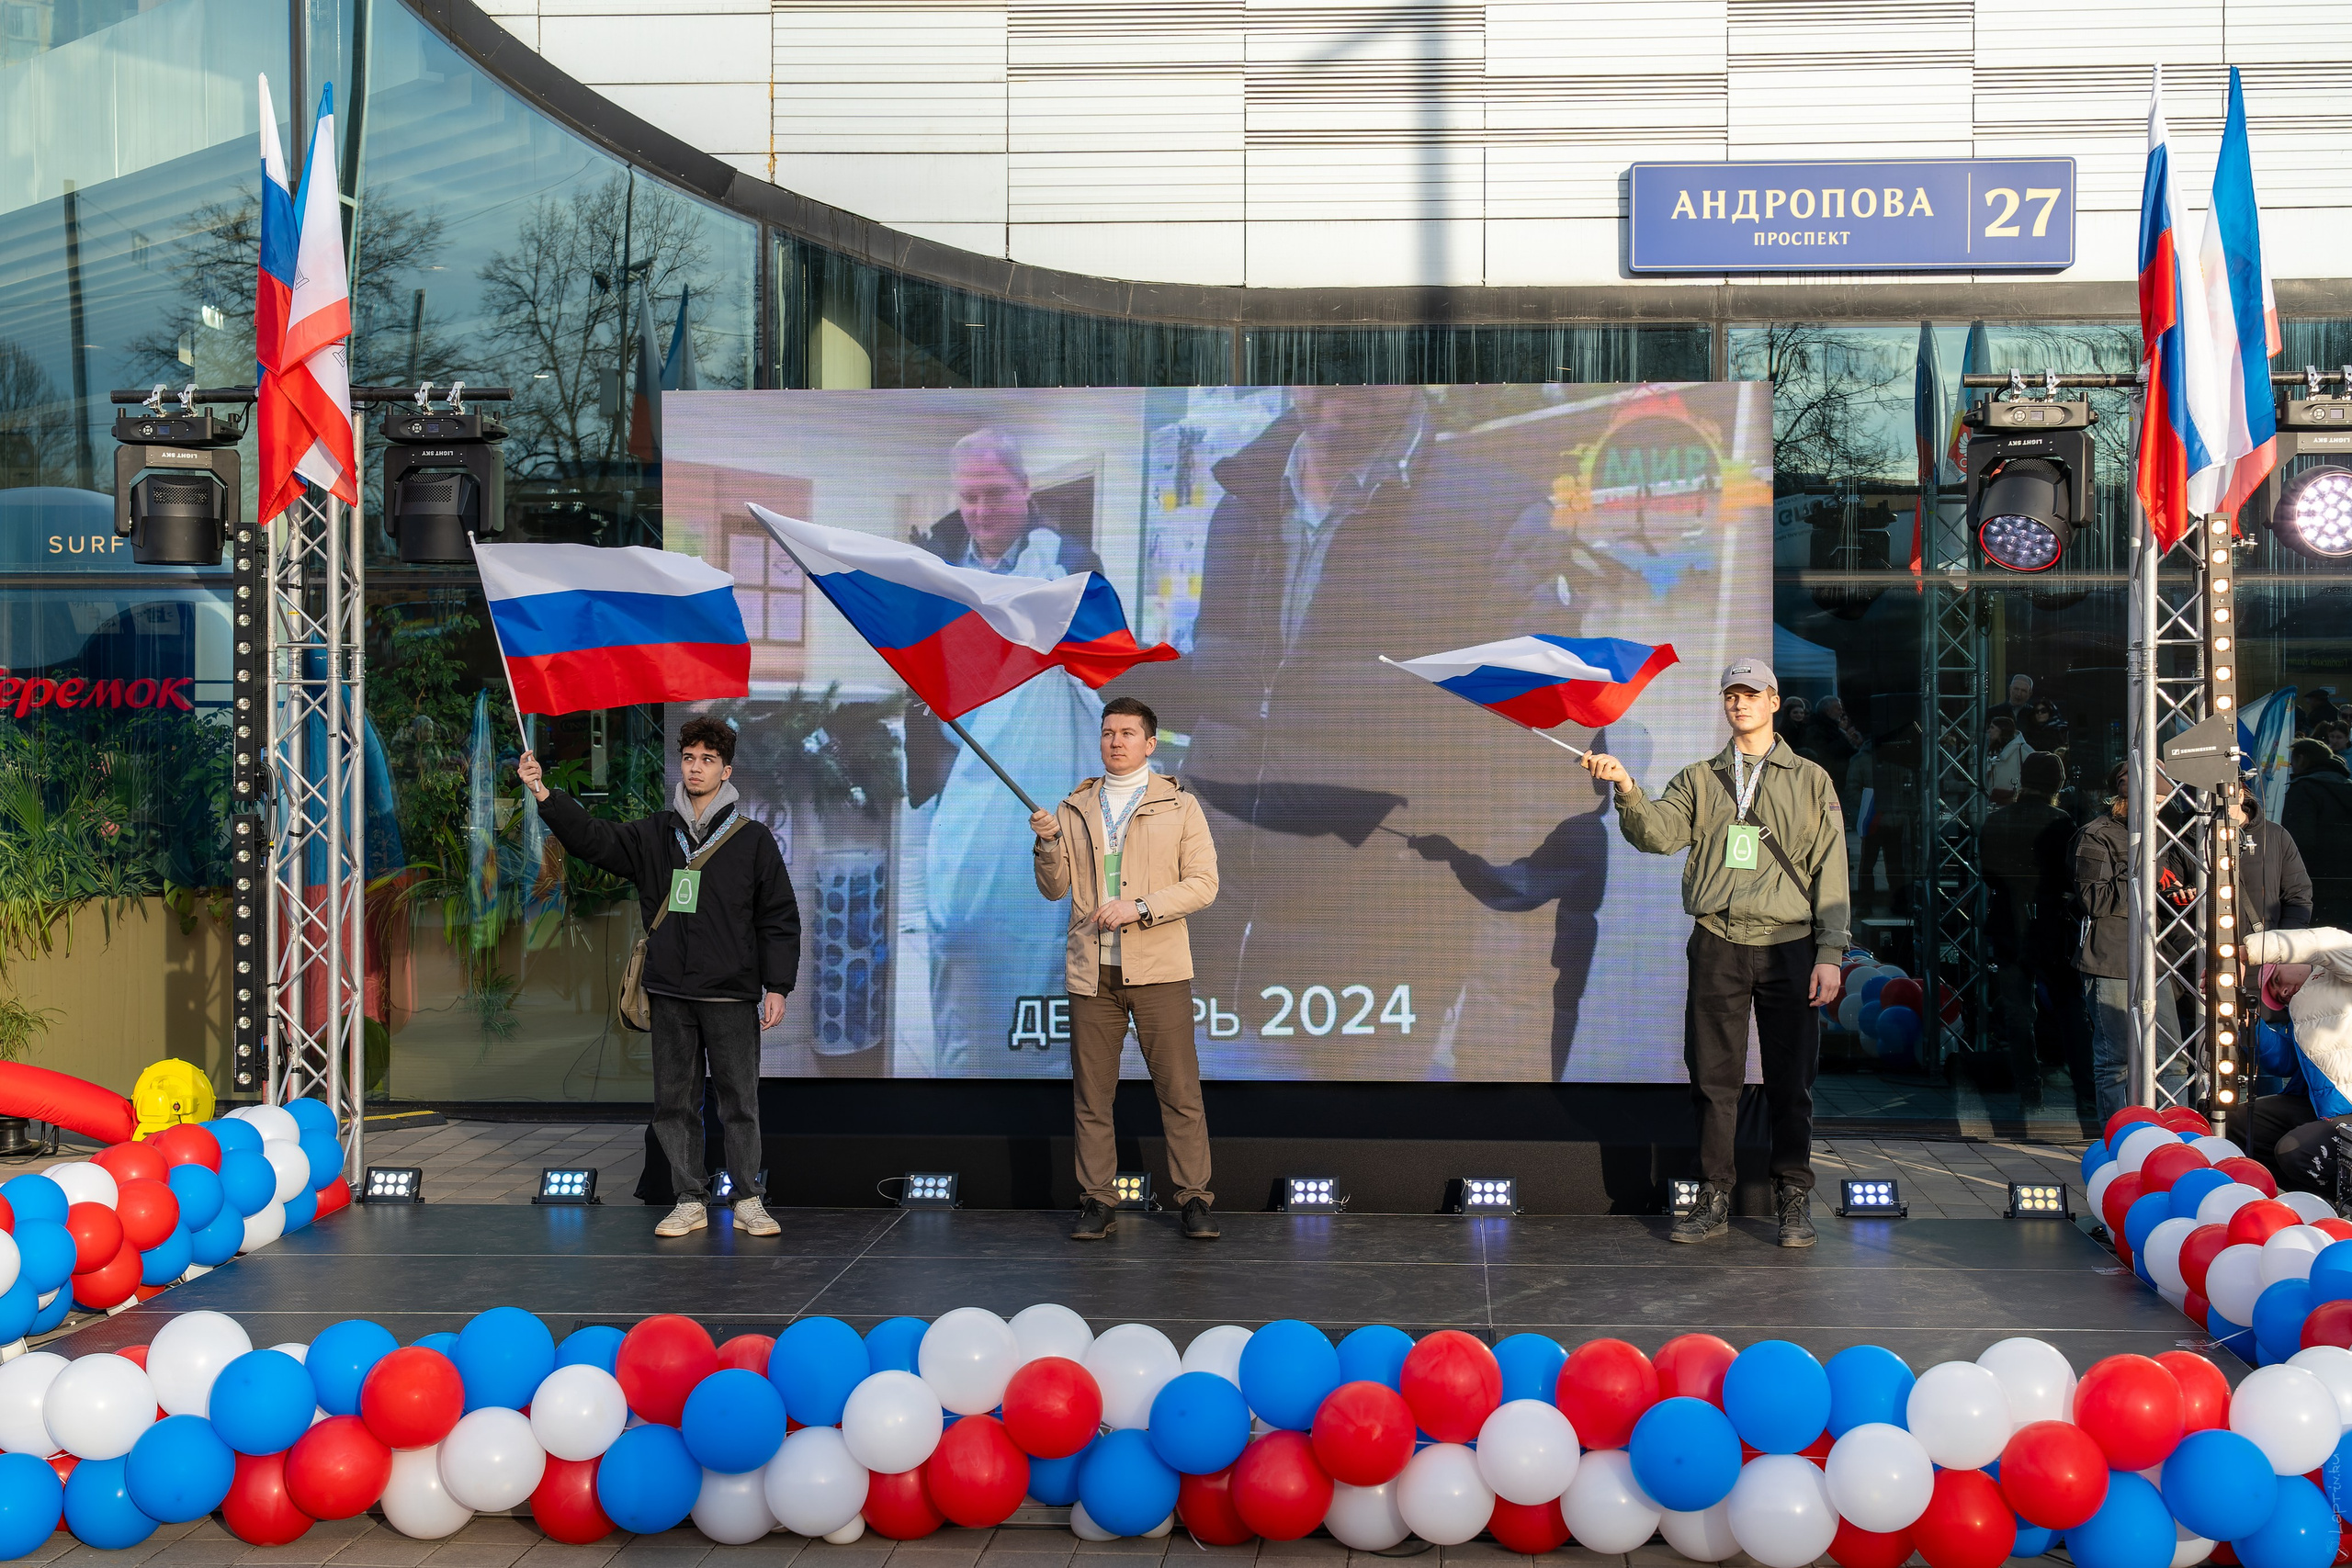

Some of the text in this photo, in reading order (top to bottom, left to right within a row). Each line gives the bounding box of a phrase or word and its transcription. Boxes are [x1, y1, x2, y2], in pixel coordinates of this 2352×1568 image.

[1670, 186, 1934, 224] АНДРОПОВА
[1984, 186, 2063, 239] 27
[1753, 231, 1851, 246] ПРОСПЕКТ
[1601, 444, 1710, 488] МИР
[49, 535, 125, 554] SURF
[0, 667, 195, 719] еремок
[2180, 746, 2217, 754] SENNHEISER
[1260, 984, 1417, 1037] 2024
